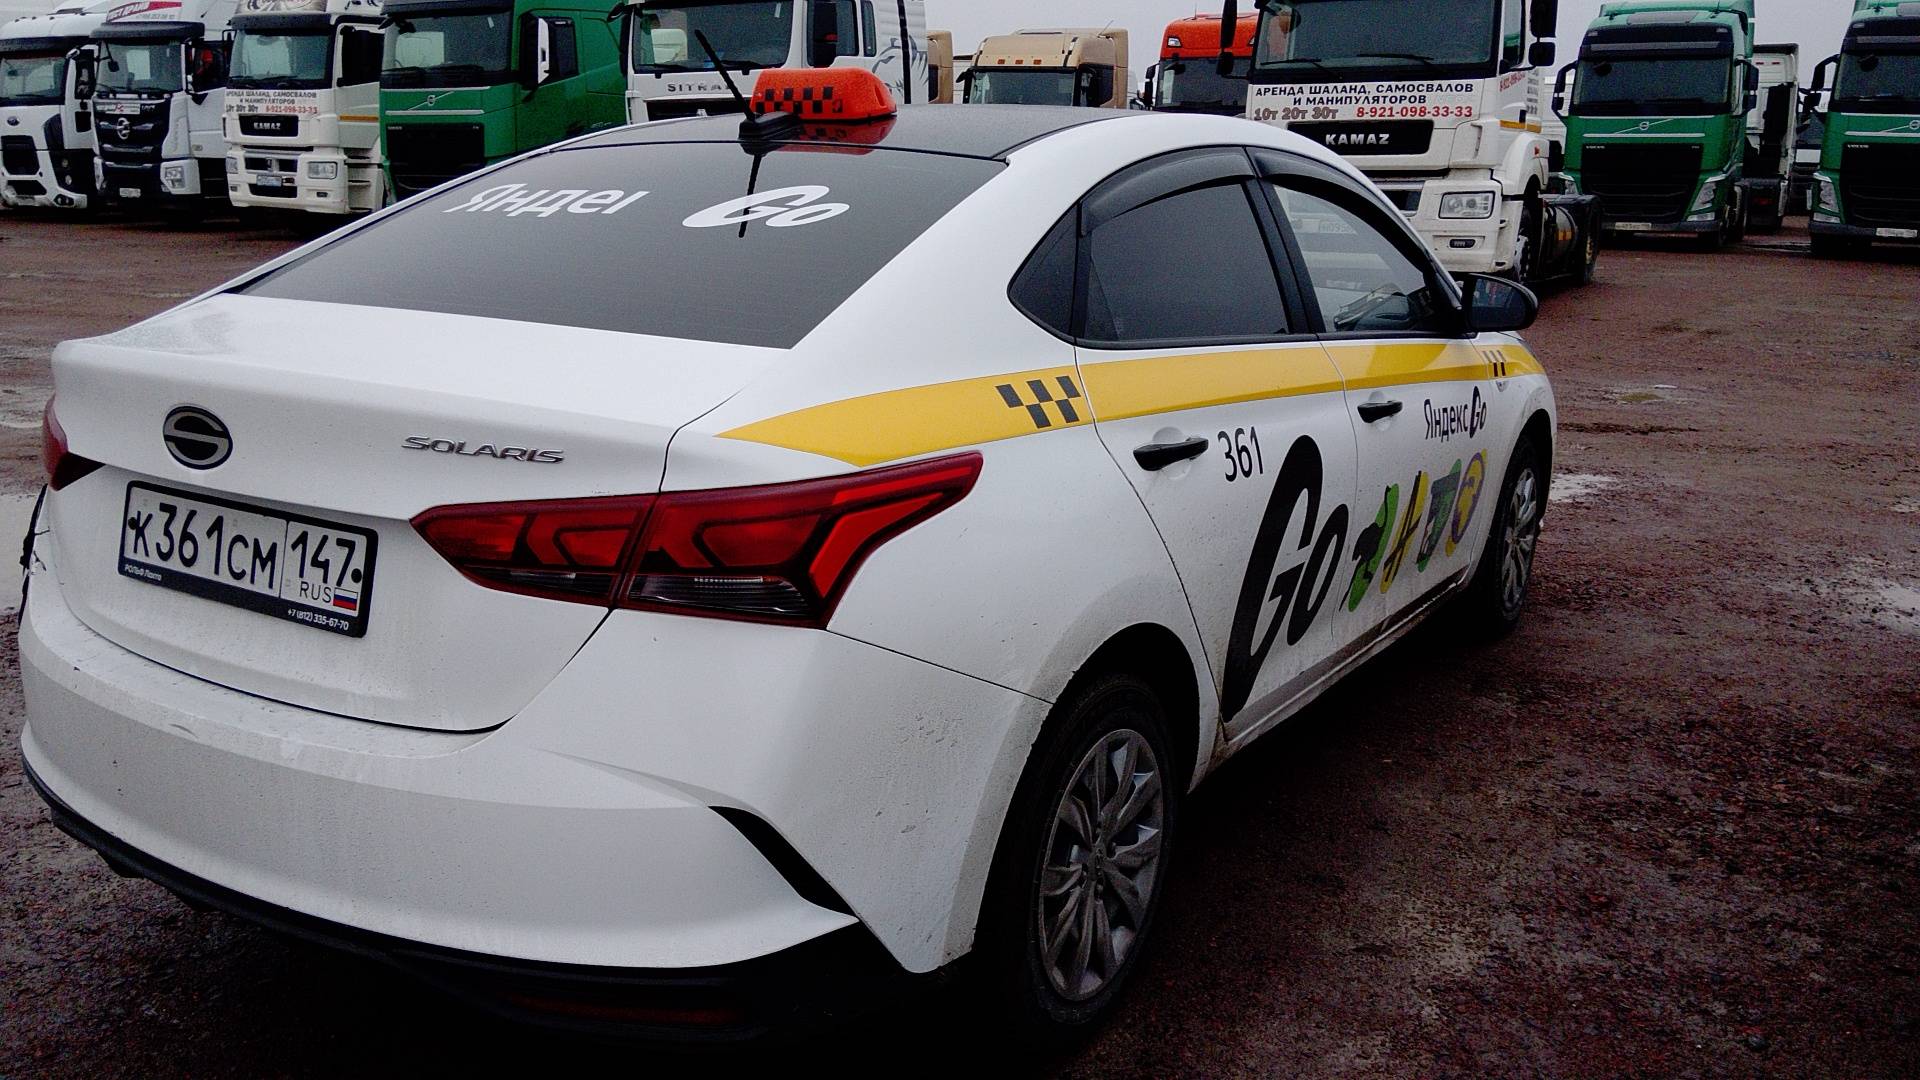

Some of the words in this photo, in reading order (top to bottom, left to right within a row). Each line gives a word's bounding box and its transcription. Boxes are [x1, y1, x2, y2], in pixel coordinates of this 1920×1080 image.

[667, 83, 731, 92] SITRA
[1255, 86, 1305, 96] АРЕНДА
[1309, 85, 1371, 95] ШАЛАНД,
[1376, 83, 1474, 93] САМОСВАЛОВ
[1293, 97, 1302, 105] И
[1306, 95, 1427, 105] МАНИПУЛЯТОРОВ
[1356, 106, 1473, 117] 8-921-098-33-33
[1325, 133, 1390, 145] KAMAZ
[682, 185, 850, 228] Go
[1424, 398, 1468, 443] Яндекс
[1469, 385, 1487, 439] Go
[402, 434, 564, 465] SOLARIS
[1217, 426, 1264, 482] 361
[291, 530, 356, 587] 147
[1220, 434, 1349, 722] Go
[299, 581, 332, 603] RUS
[296, 609, 314, 622] (812)
[313, 613, 350, 631] 335-67-70
